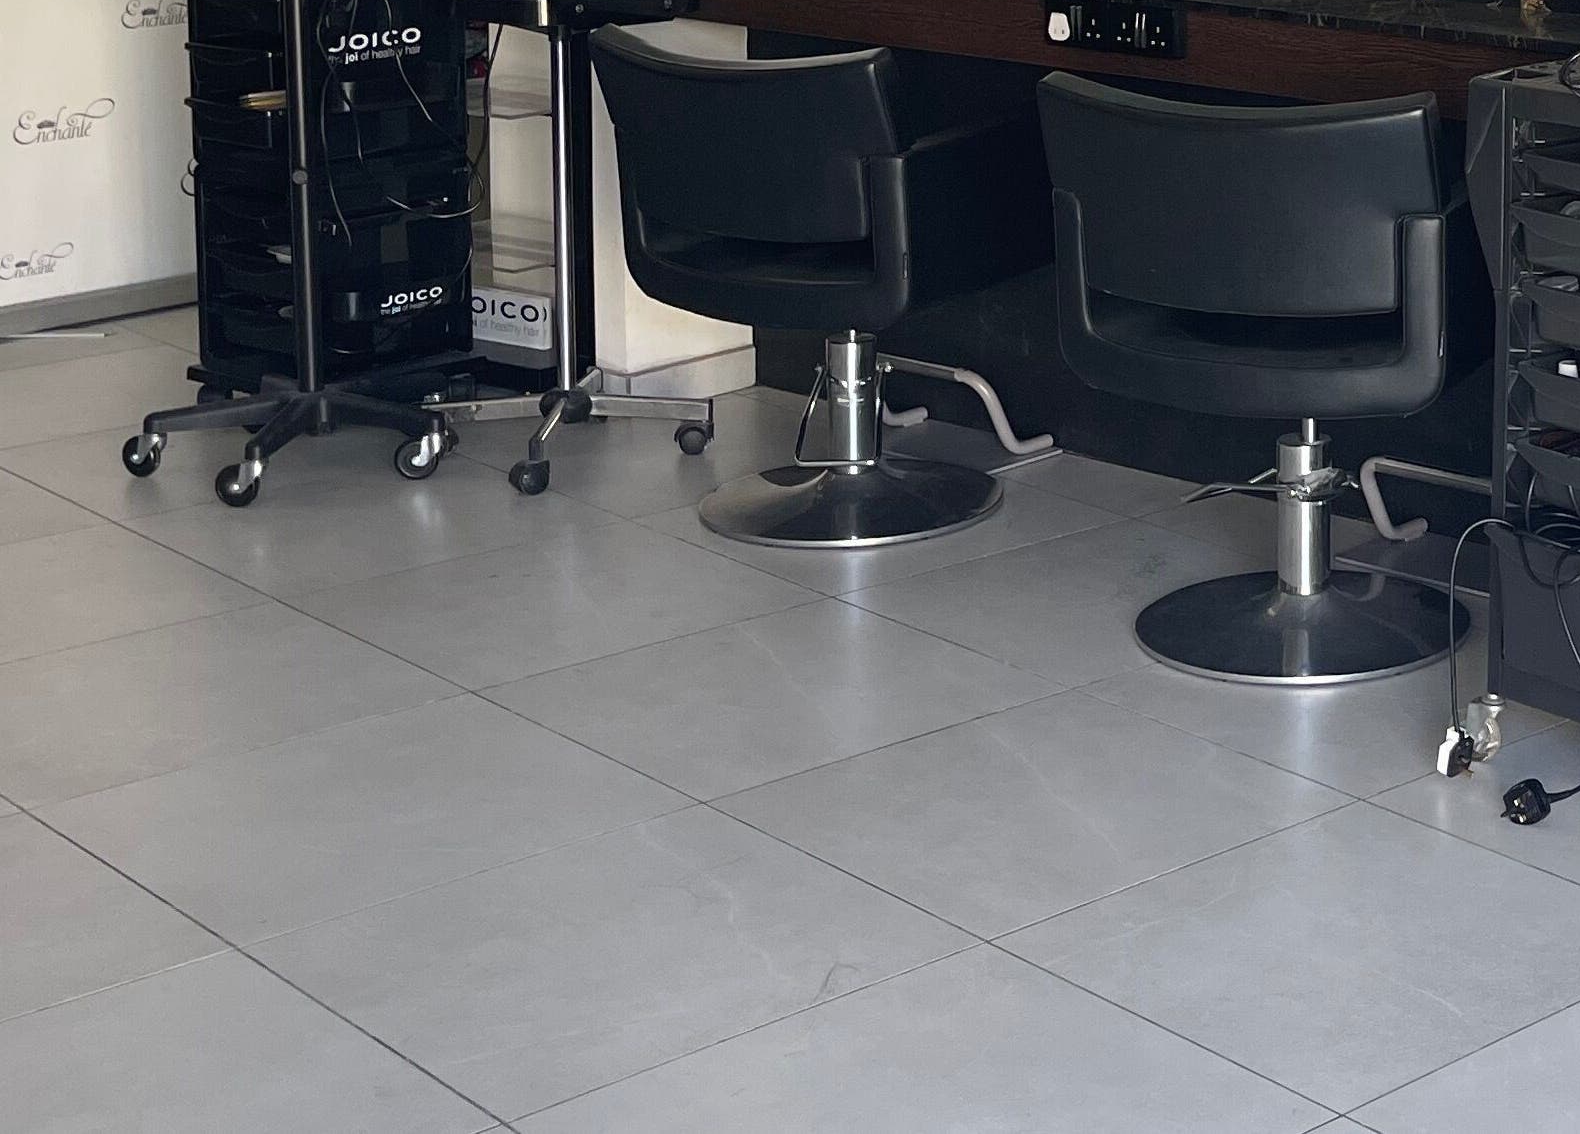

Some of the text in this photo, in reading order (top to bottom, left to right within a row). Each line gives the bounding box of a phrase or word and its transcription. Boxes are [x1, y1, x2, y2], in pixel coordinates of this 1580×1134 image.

[327, 27, 421, 53] JOICO
[12, 97, 115, 146] Enchanté
[381, 286, 443, 308] JOICO
[471, 296, 540, 323] OICO
